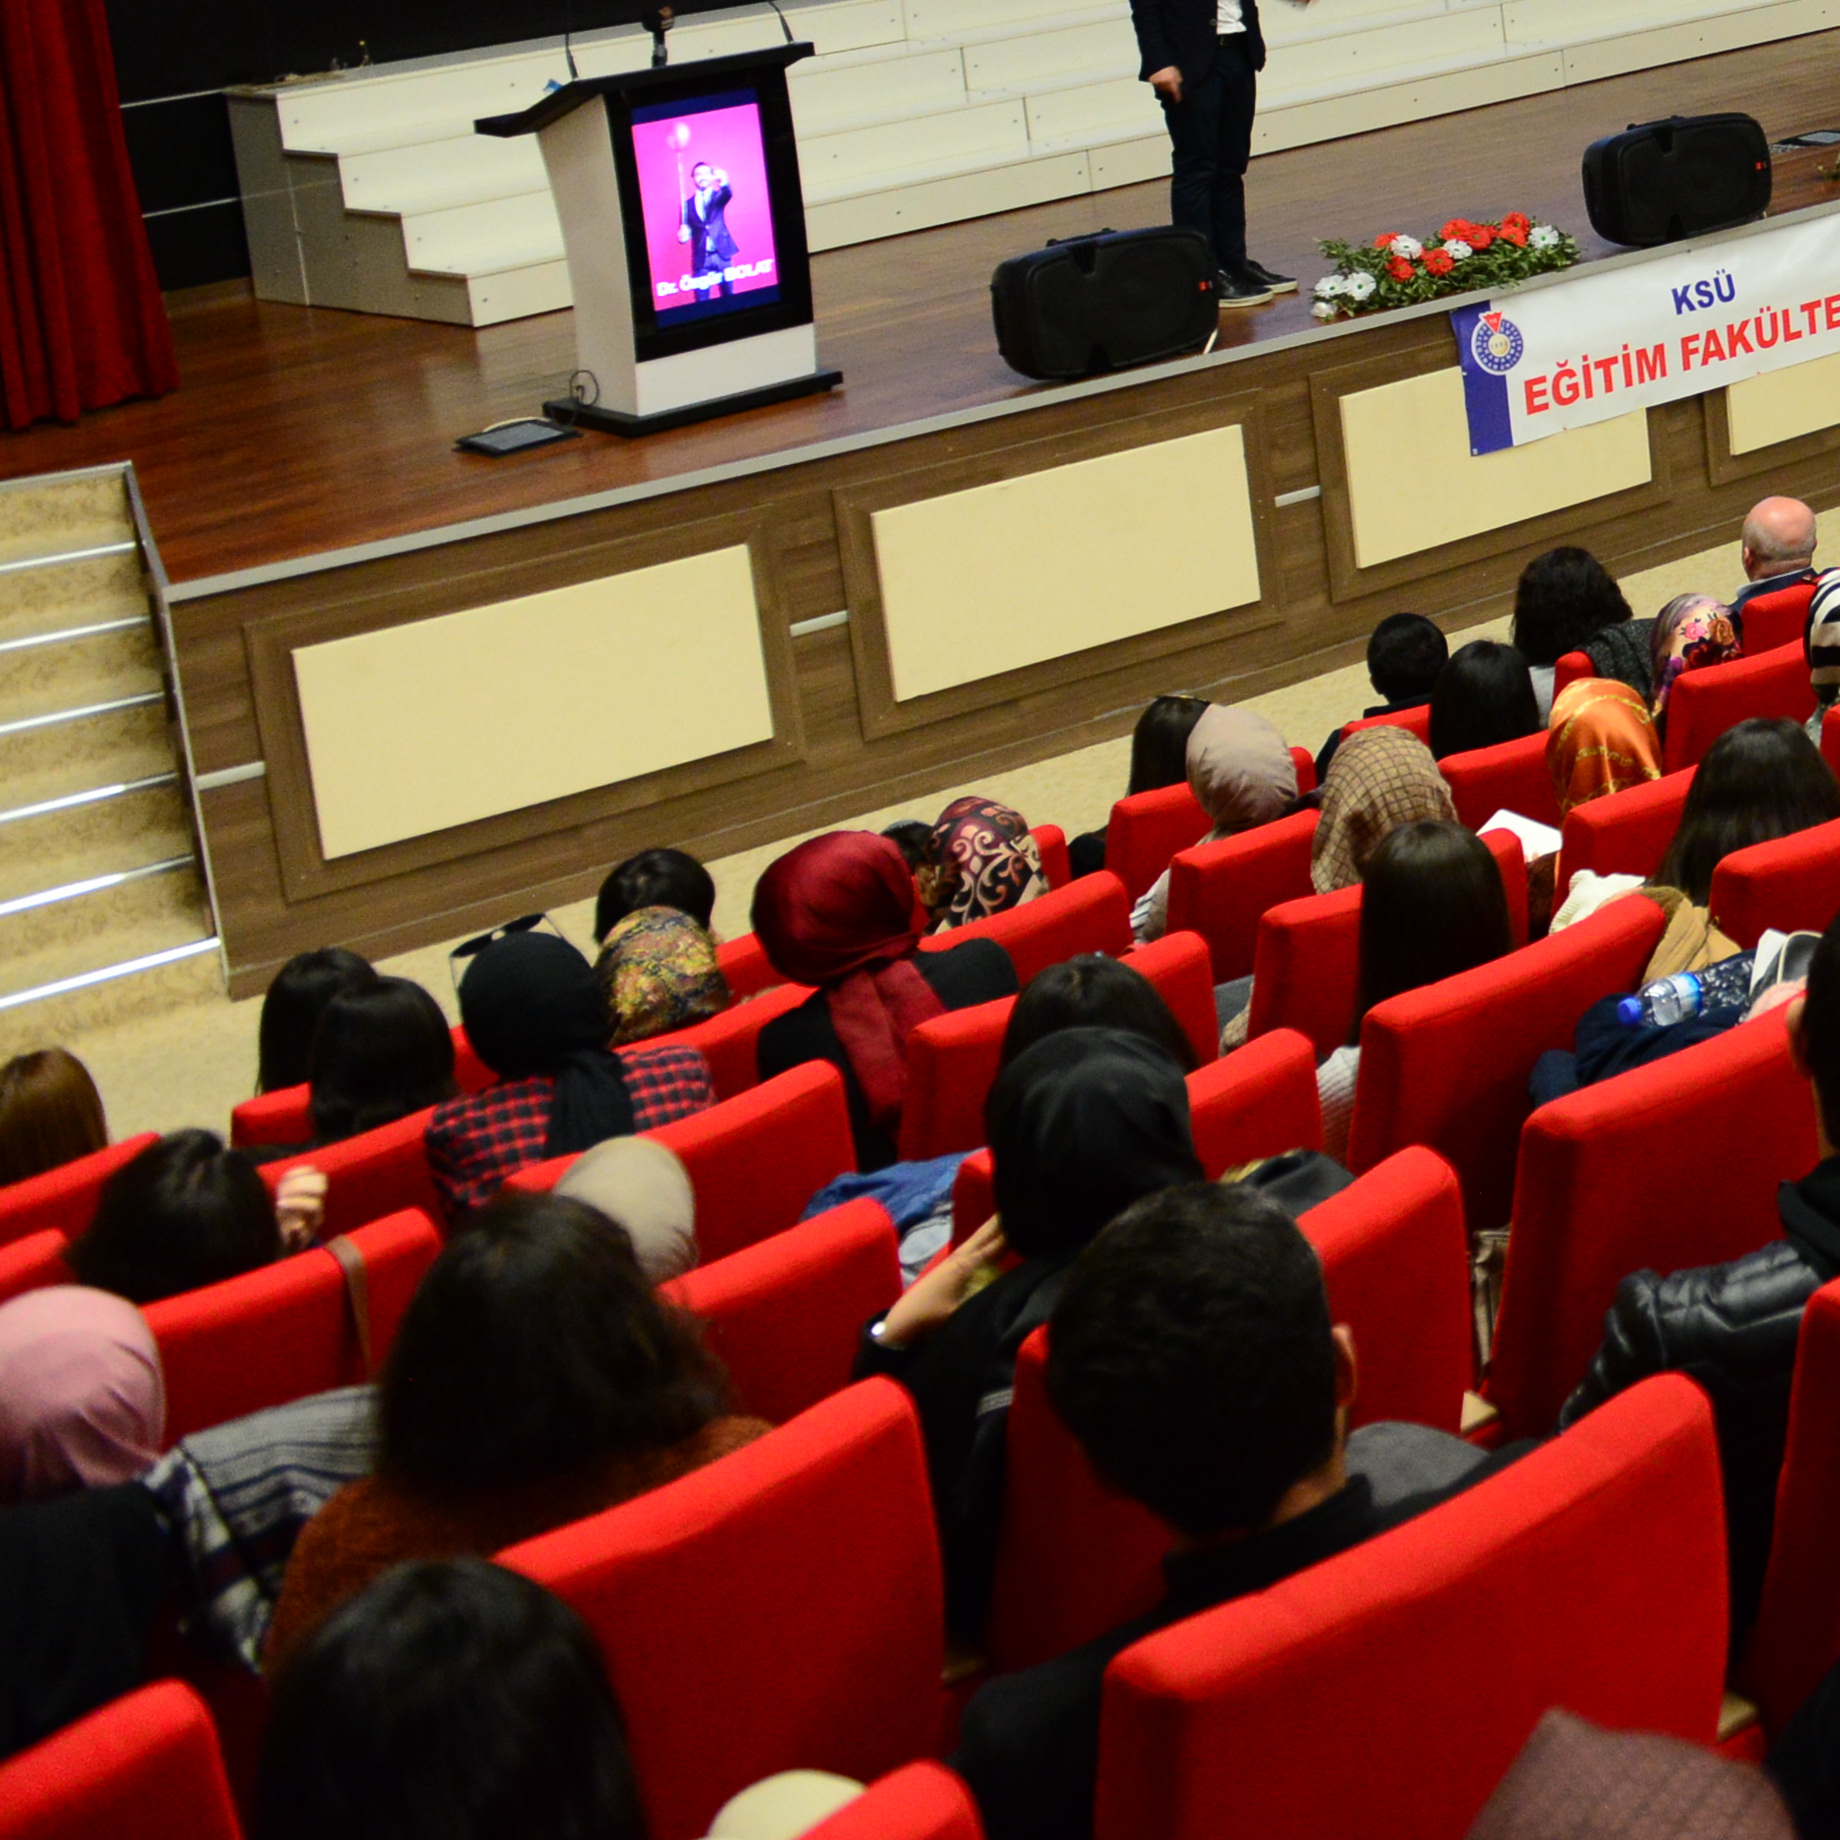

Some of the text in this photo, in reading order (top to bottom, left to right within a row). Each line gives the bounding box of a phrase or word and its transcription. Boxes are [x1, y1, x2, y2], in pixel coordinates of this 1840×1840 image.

[656, 282, 679, 297] Dr.
[724, 259, 774, 282] BOLAT
[1671, 269, 1736, 315] KSÜ
[1524, 342, 1668, 416] EĞİTİM
